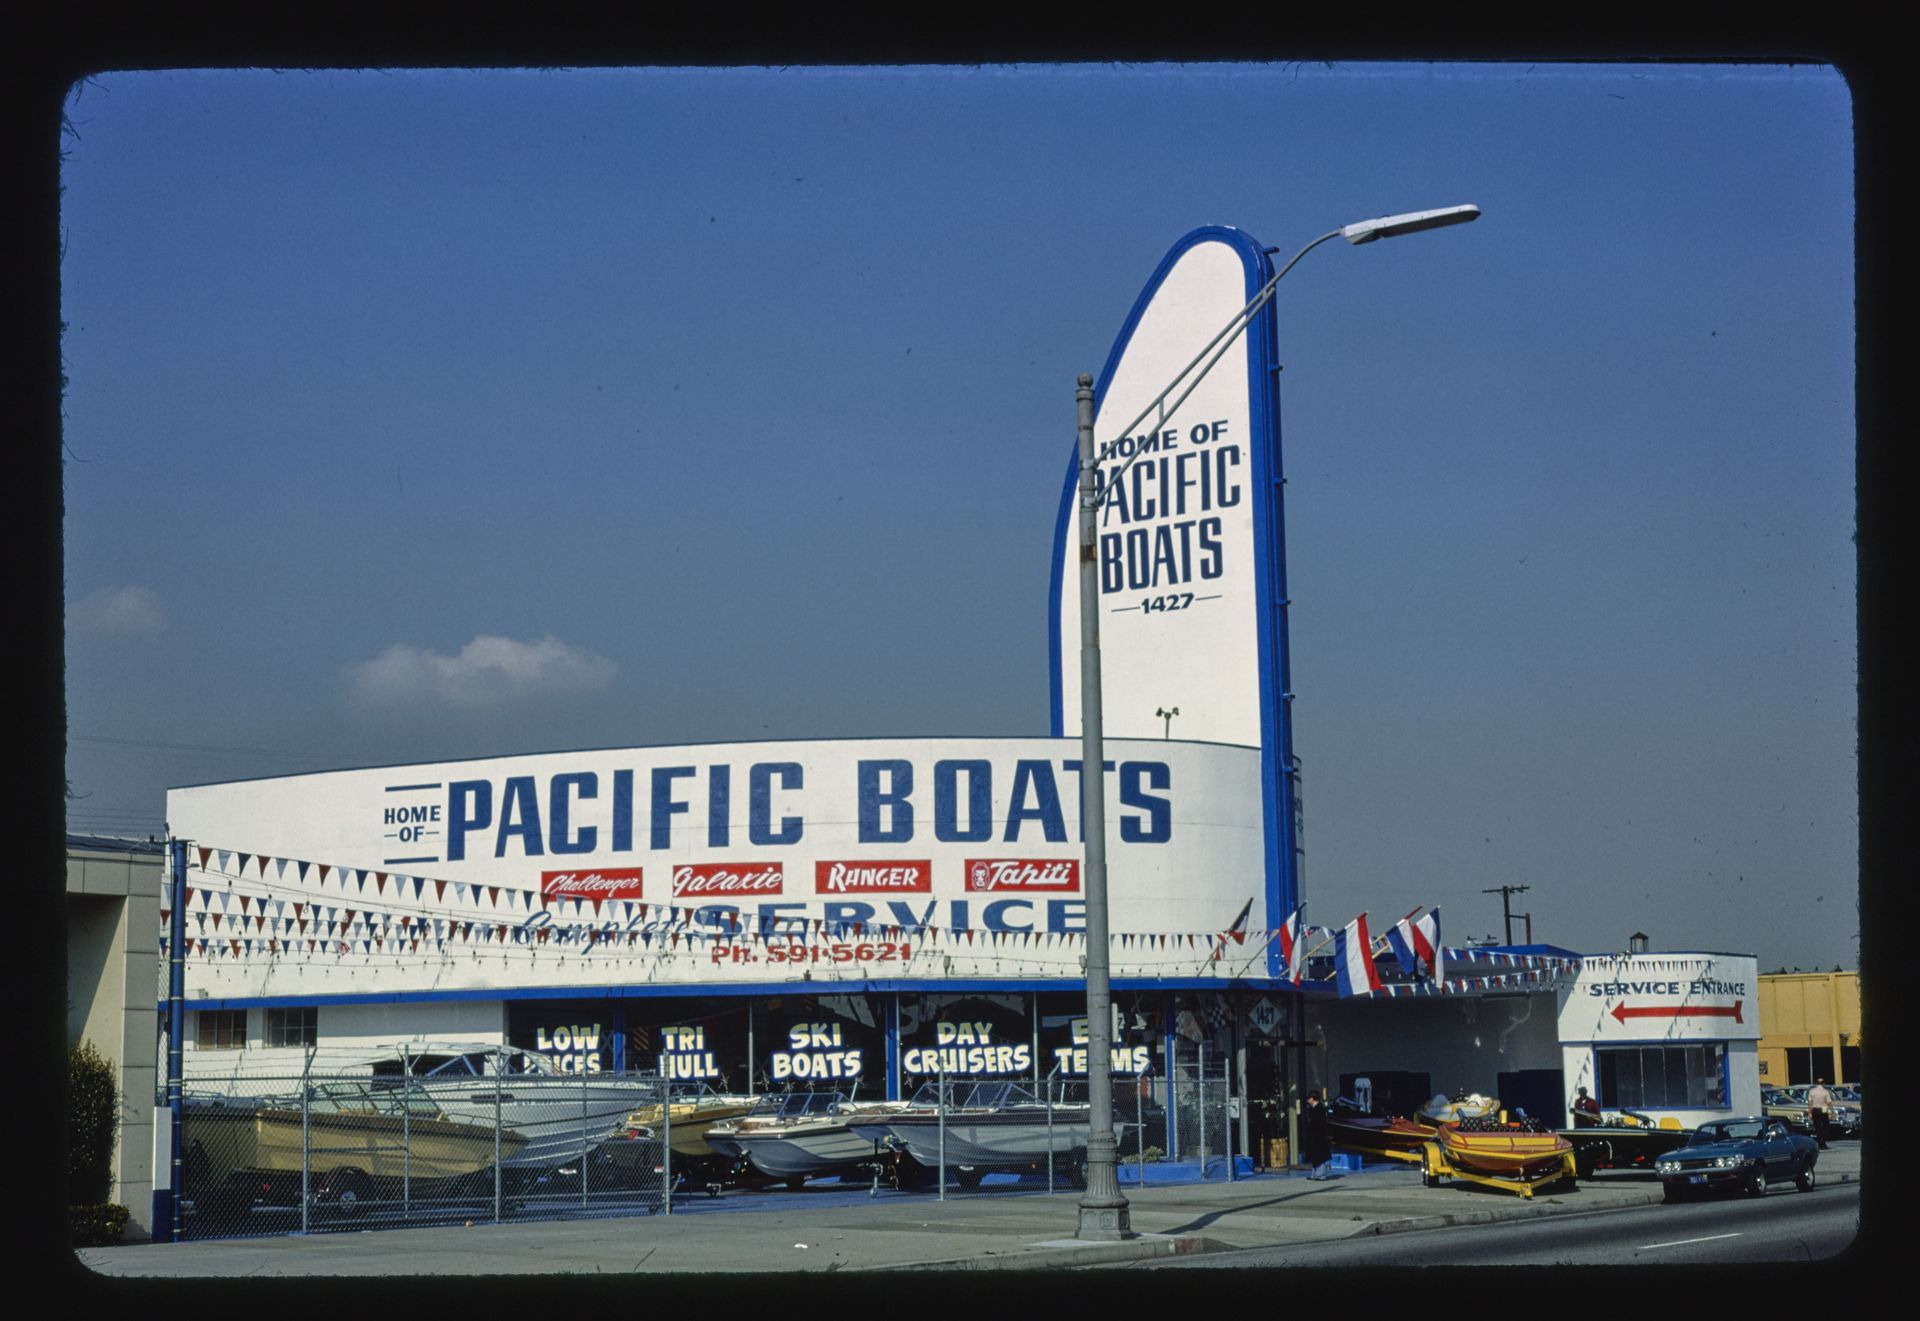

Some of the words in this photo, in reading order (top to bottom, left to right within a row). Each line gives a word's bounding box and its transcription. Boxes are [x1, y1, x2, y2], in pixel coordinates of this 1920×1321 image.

[1100, 429, 1178, 461] HOME
[1190, 420, 1228, 444] OF
[1101, 517, 1223, 594] BOATS
[1141, 593, 1194, 614] 1427
[384, 805, 441, 825] HOME
[447, 762, 803, 861] PACIFIC
[858, 759, 1171, 844] BOATS
[399, 826, 424, 842] OF
[544, 871, 640, 898] Challenger
[672, 866, 783, 898] Galaxie
[828, 862, 919, 893] RANGER
[987, 861, 1072, 891] Tahiti
[516, 910, 704, 956] Complete
[694, 900, 1087, 936] SERVICE
[711, 946, 758, 963] Ph.
[1589, 981, 1680, 997] SERVICE
[1690, 980, 1745, 996] ENTRANCE
[537, 1023, 601, 1051] LOW
[661, 1026, 704, 1051] TRI
[789, 1022, 842, 1049] SKI
[937, 1021, 993, 1045] DAY
[524, 1052, 601, 1076] ICES
[659, 1053, 719, 1078] HULL
[773, 1051, 861, 1079] BOATS
[904, 1044, 1031, 1074] CRUISERS
[1054, 1046, 1151, 1074] TEMS
